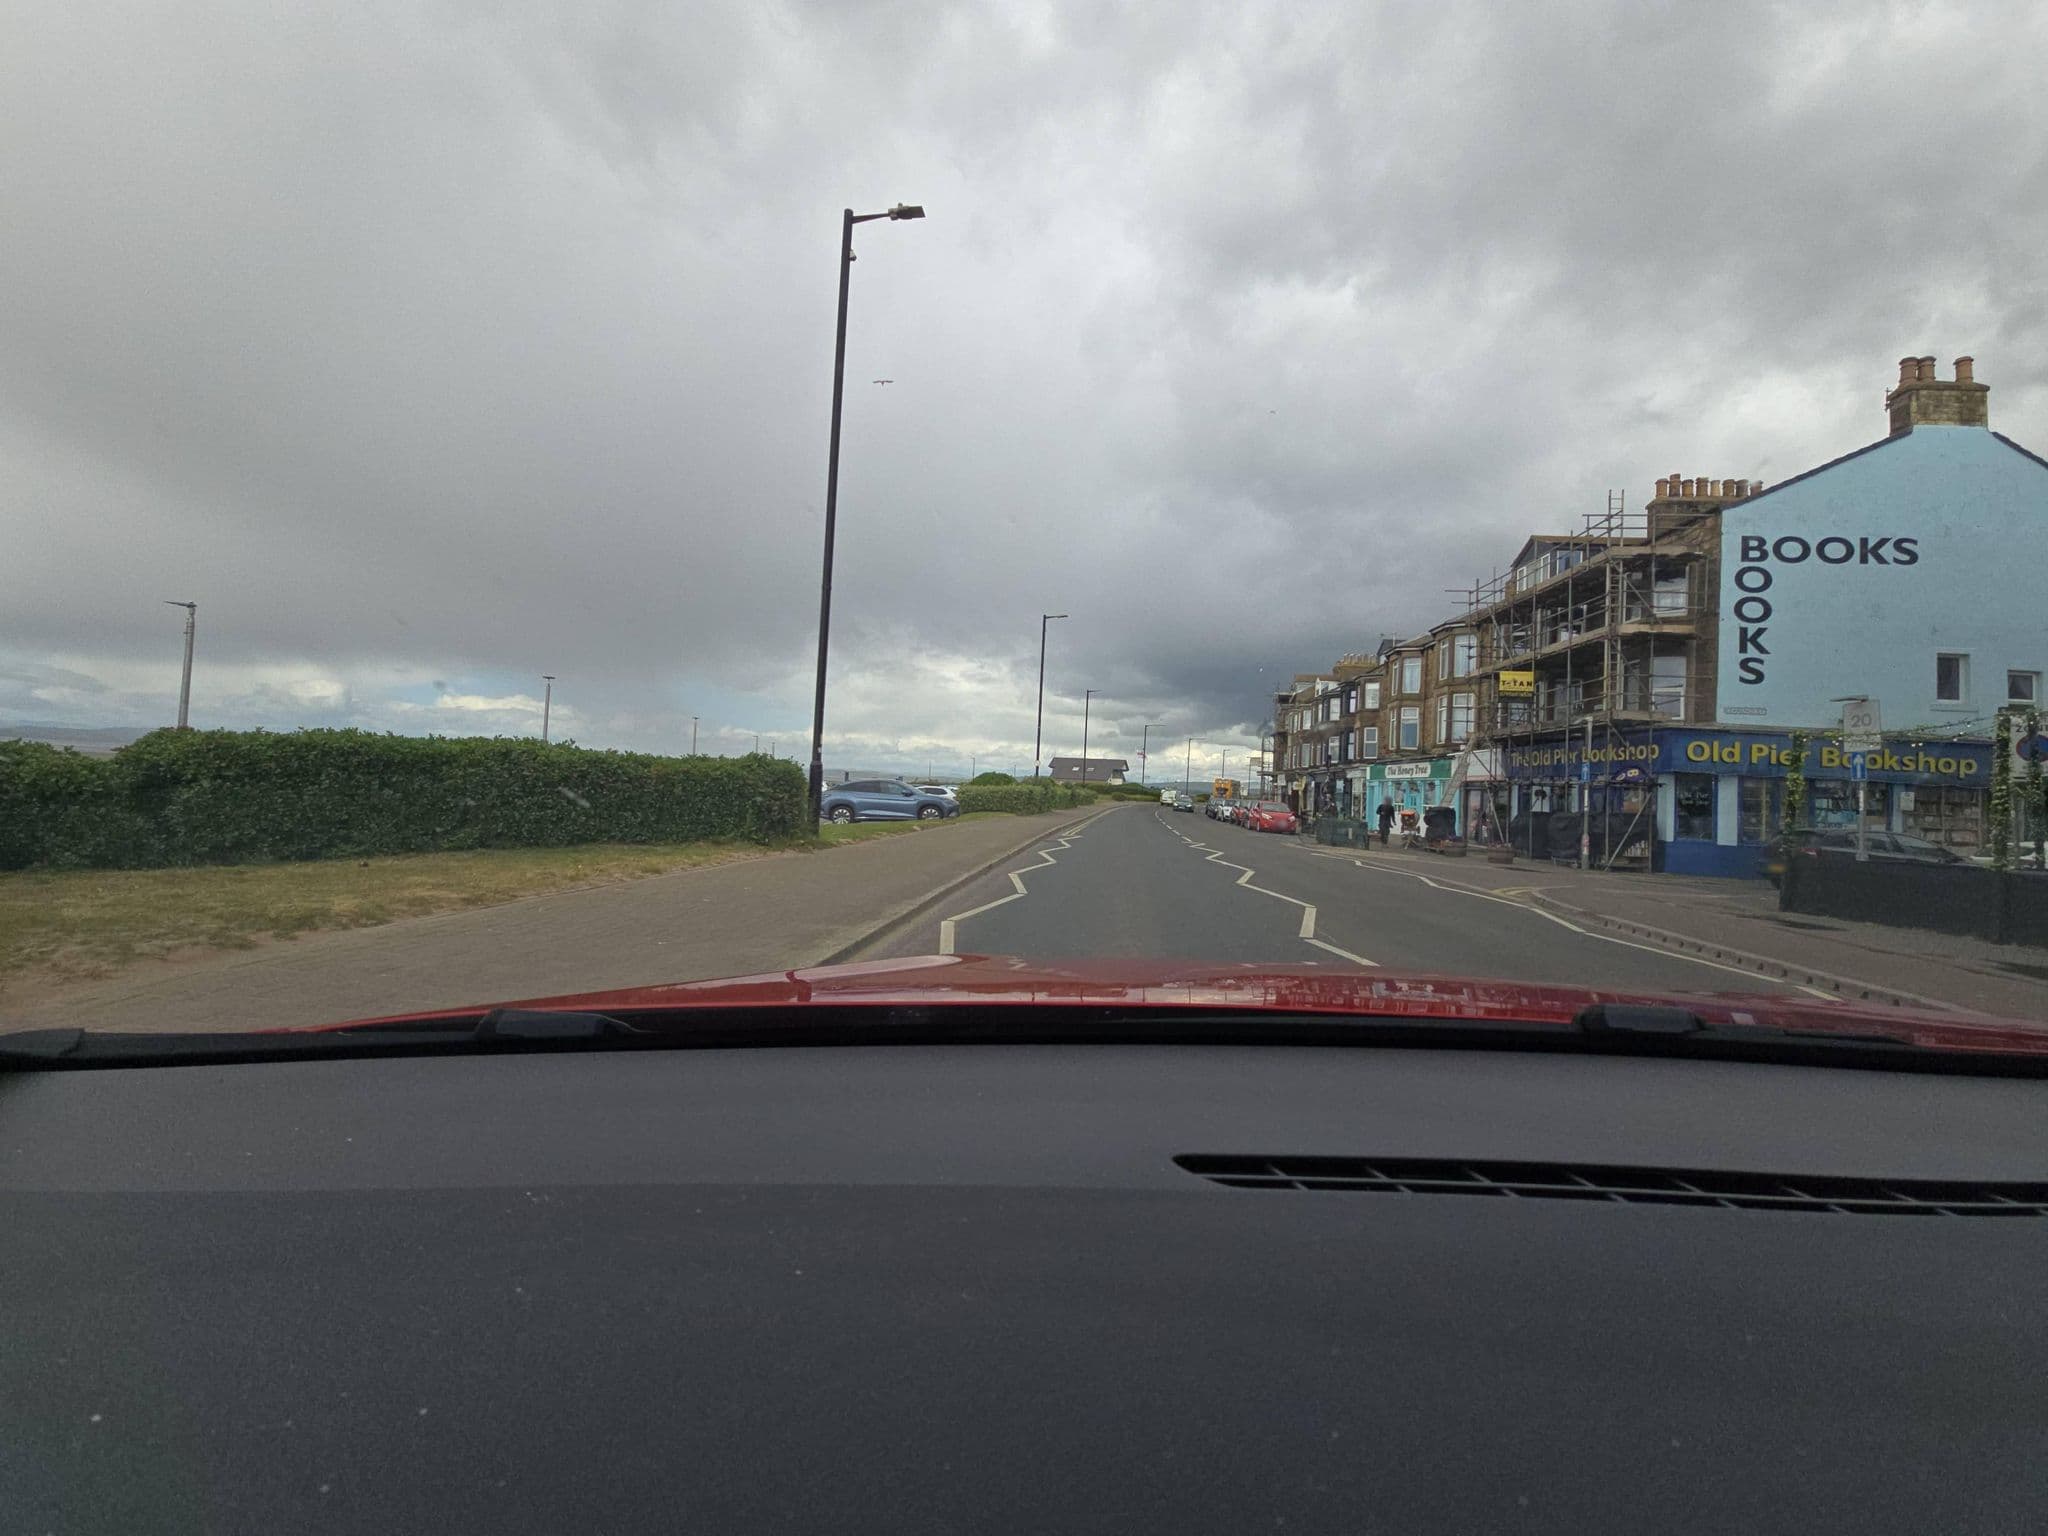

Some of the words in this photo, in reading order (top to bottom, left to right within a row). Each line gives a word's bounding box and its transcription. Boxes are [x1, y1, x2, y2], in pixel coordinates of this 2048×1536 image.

[1740, 535, 1919, 565] BOOKS
[1851, 713, 1872, 728] 20
[1532, 749, 1551, 766] Old
[1687, 740, 1741, 764] Old
[1750, 743, 1811, 767] Pier
[1821, 747, 1978, 779] Bookshop
